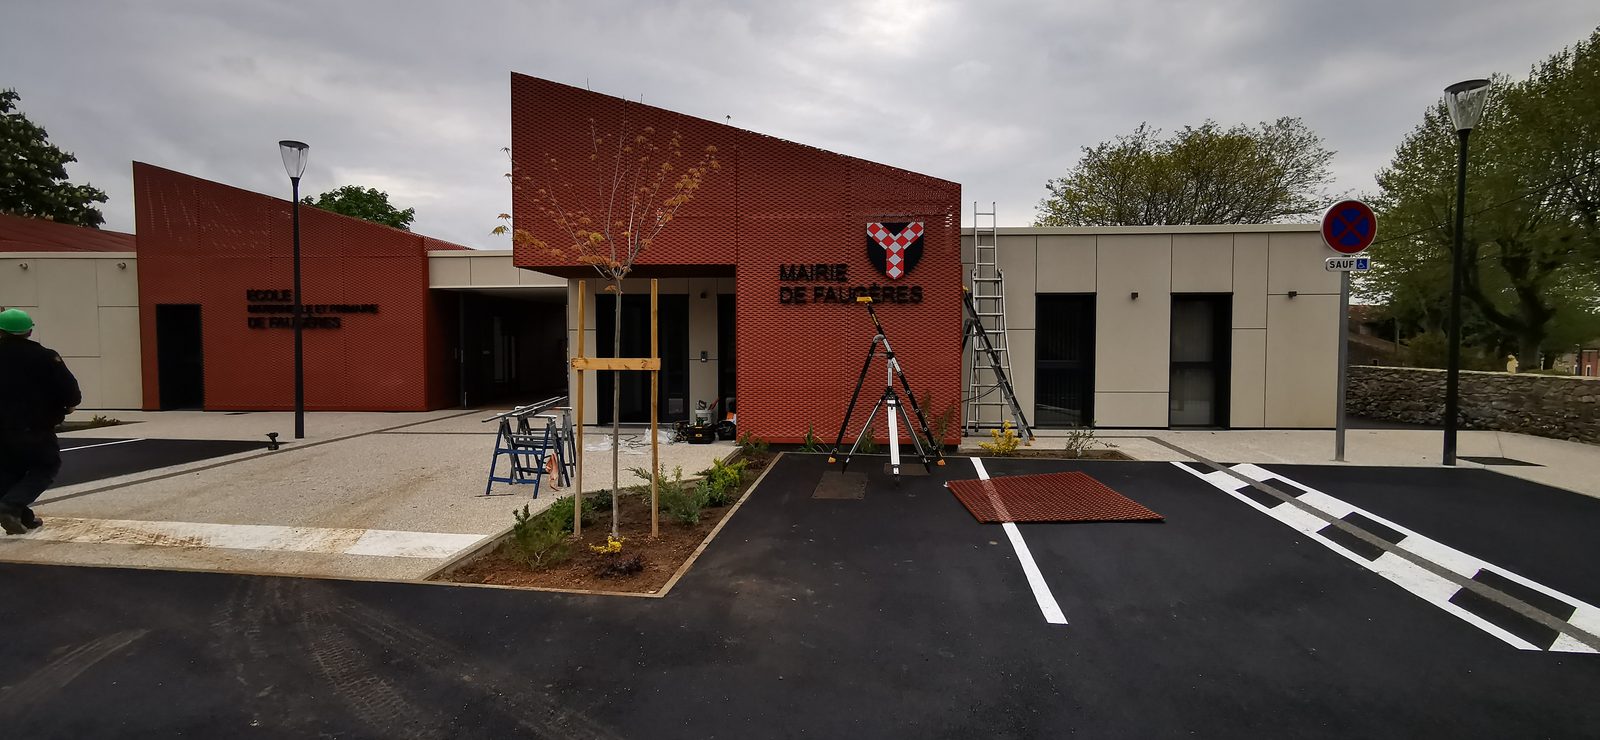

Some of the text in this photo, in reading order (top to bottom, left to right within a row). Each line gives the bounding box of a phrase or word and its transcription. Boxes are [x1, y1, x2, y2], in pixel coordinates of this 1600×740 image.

[779, 263, 849, 281] MAIRIE
[1329, 260, 1354, 269] SAUF
[779, 285, 807, 304] DE
[248, 317, 266, 329] DE
